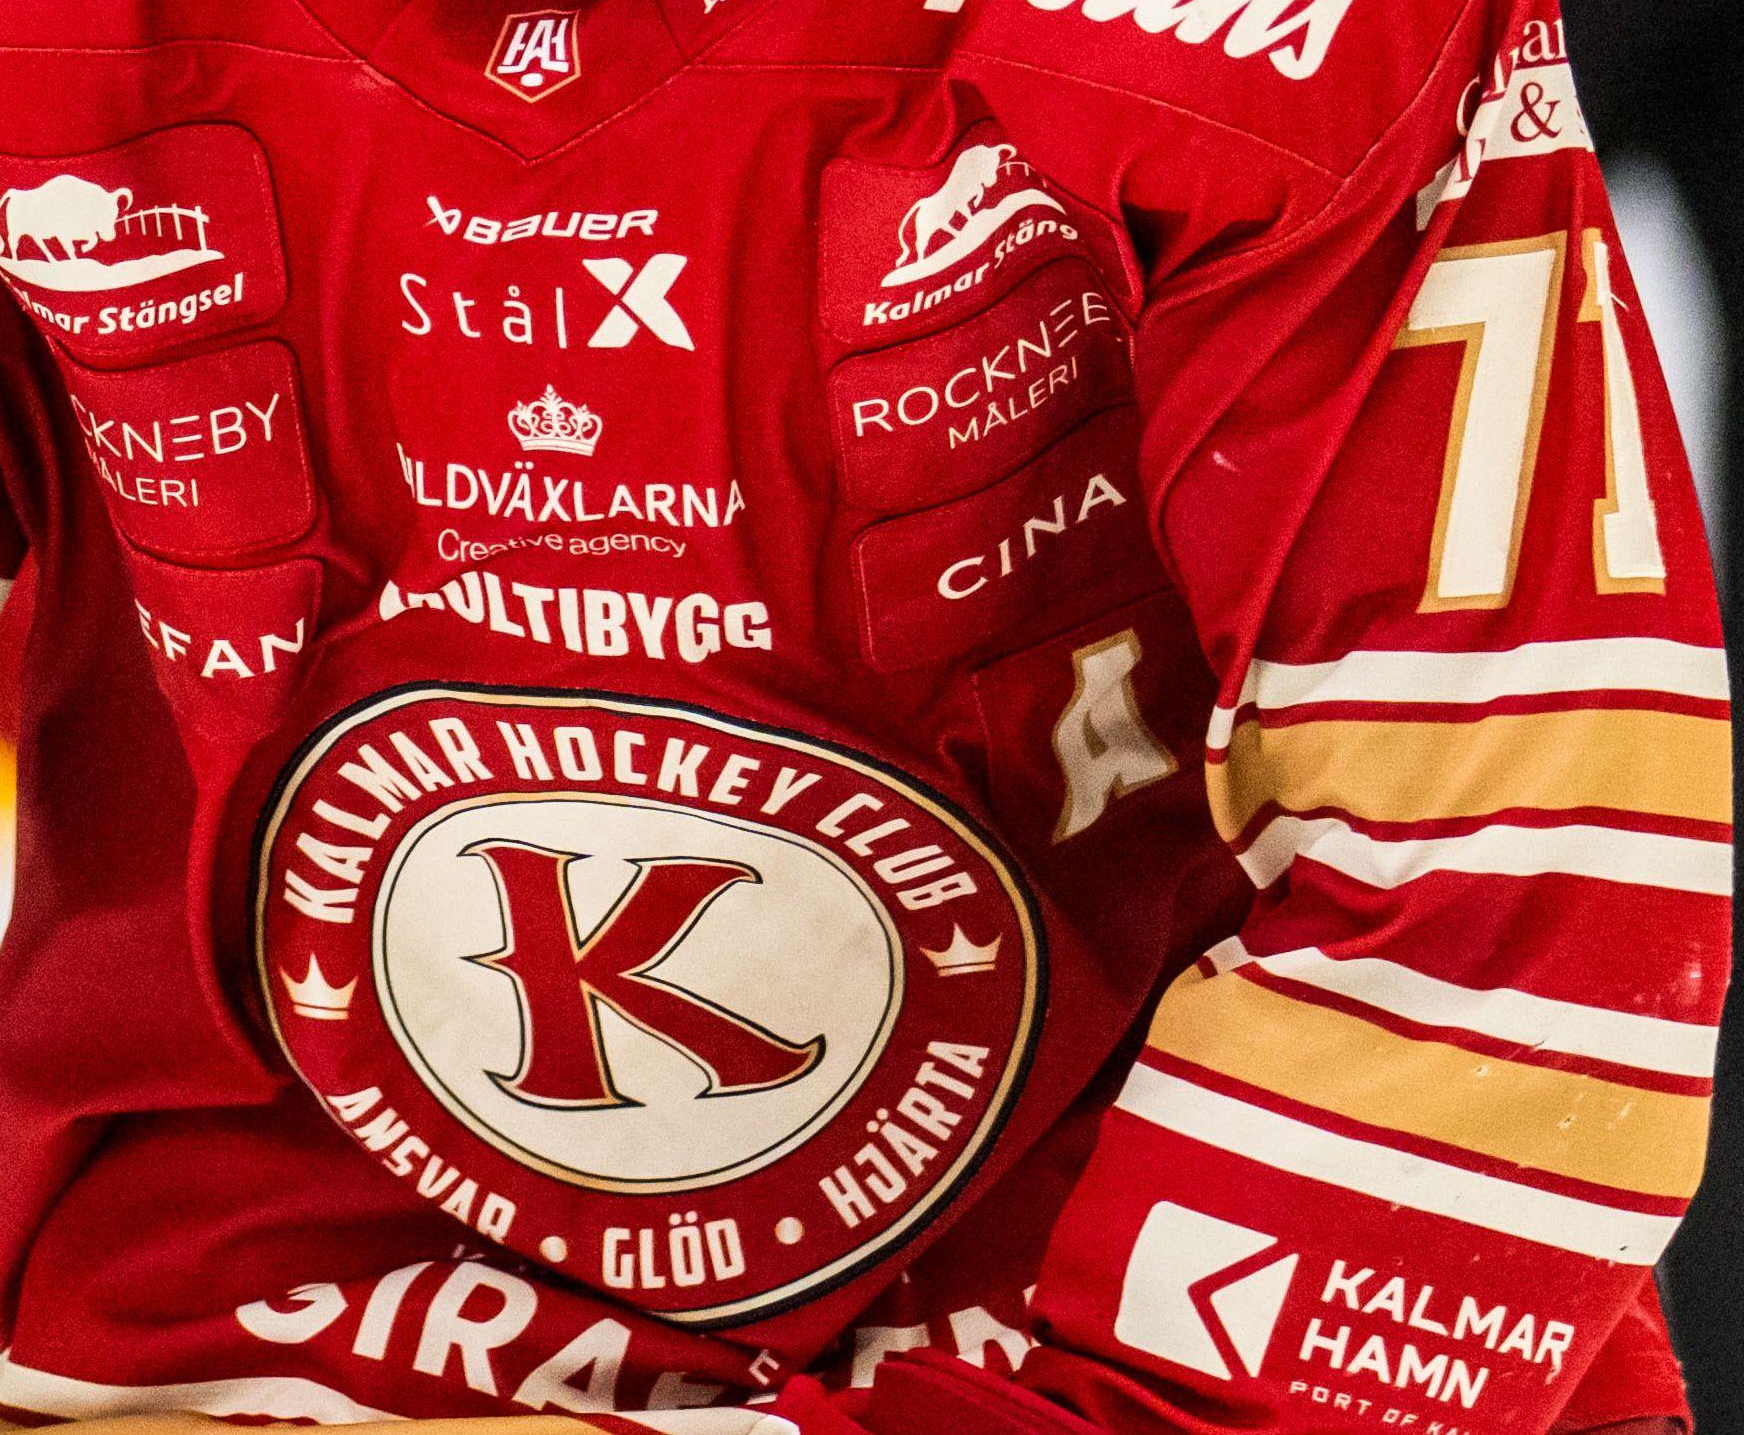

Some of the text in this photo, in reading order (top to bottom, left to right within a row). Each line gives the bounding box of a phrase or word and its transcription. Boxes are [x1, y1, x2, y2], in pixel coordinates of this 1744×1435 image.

[462, 208, 659, 246] BAUER
[862, 218, 1079, 326] Kalmar Stäng
[97, 271, 245, 335] Stängsel
[70, 392, 281, 464] CKNEBY
[947, 355, 1078, 450] MÅLERI
[1392, 227, 1667, 614] 71
[437, 527, 688, 563] Creative agency
[937, 473, 1127, 600] CINA
[1051, 628, 1179, 845] A
[282, 716, 979, 924] KALMAR HOCKEY CLUB
[456, 837, 826, 1111] K
[326, 1039, 991, 1290] ANSVAR GLÖD HJÄRTA
[1298, 1317, 1491, 1410] HAMN
[1320, 1258, 1576, 1368] KALMAR
[1289, 1379, 1420, 1427] PORT OF
